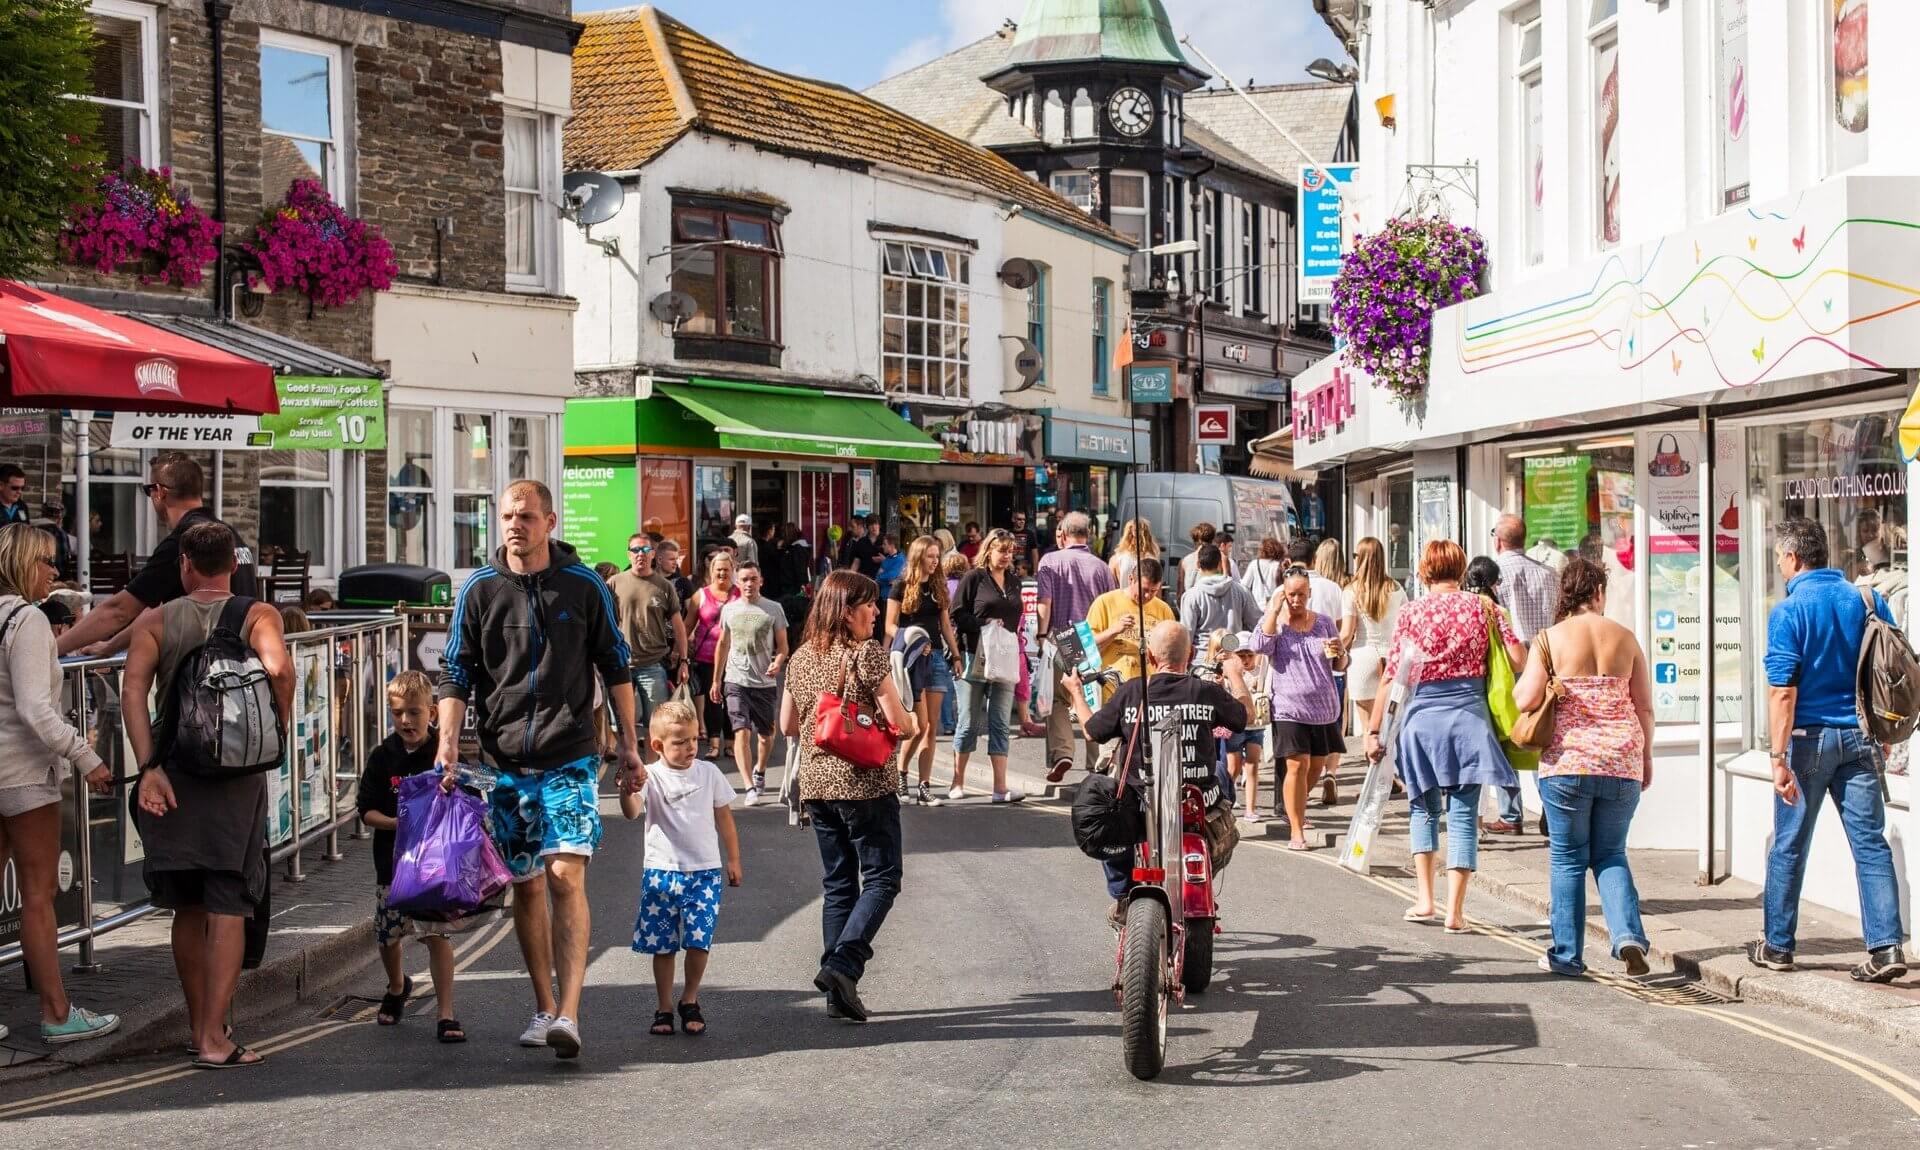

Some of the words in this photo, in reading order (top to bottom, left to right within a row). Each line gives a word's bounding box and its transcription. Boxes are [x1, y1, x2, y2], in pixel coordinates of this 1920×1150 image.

[137, 362, 177, 389] SMIRNOFF
[287, 384, 310, 393] Good
[312, 384, 337, 395] Family
[340, 385, 361, 394] Food
[281, 397, 310, 407] Award
[312, 398, 344, 409] Winning
[346, 398, 378, 408] Coffees
[298, 417, 324, 426] Served
[132, 426, 154, 440] OF
[158, 427, 189, 441] THE
[193, 428, 233, 441] YEAR
[289, 429, 310, 440] Daily
[312, 429, 333, 438] Until
[336, 415, 366, 444] 10
[1659, 508, 1690, 522] kipling
